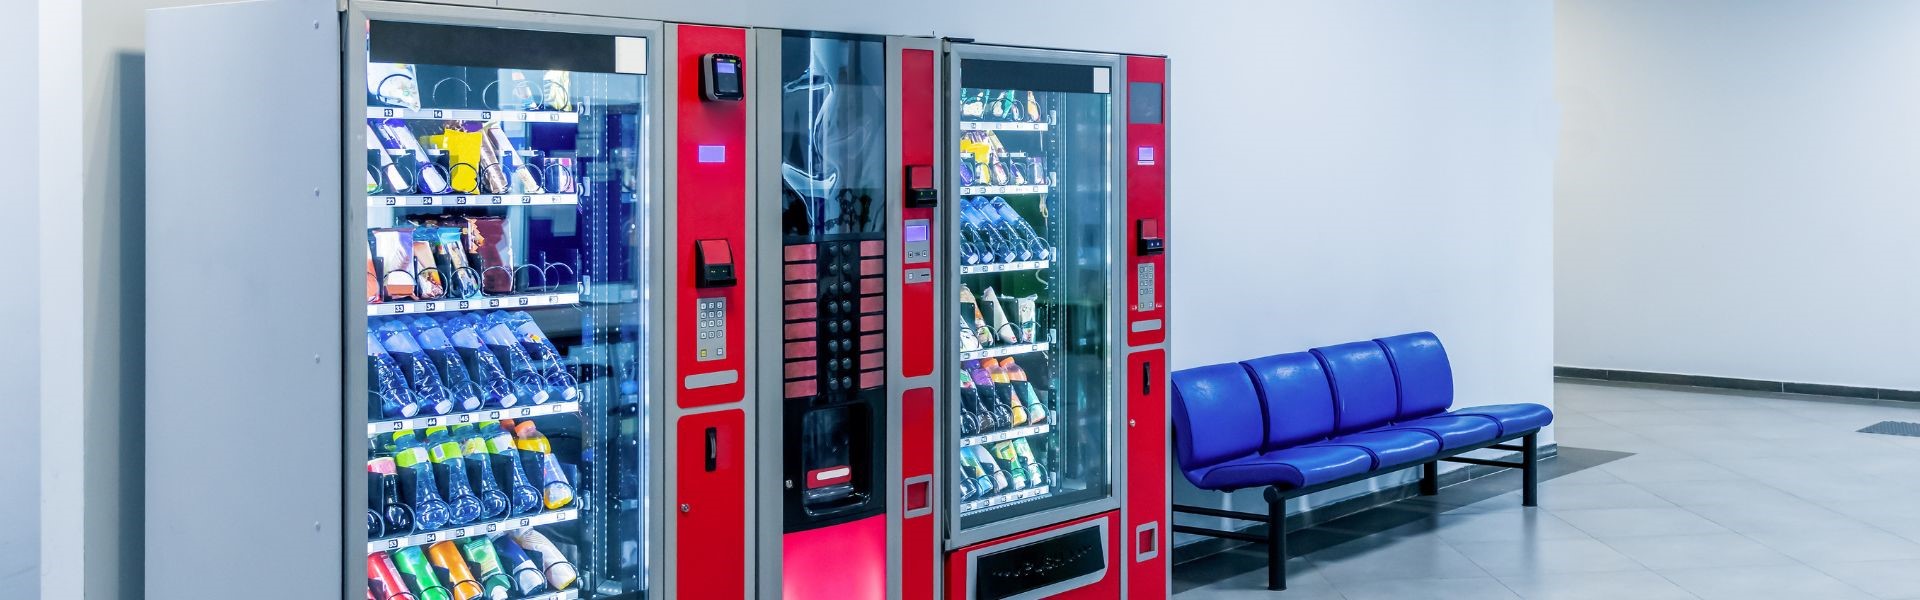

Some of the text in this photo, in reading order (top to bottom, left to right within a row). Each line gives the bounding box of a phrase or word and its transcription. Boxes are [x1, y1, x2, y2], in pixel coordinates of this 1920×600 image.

[384, 109, 393, 117] 13
[434, 110, 442, 118] 14
[423, 197, 432, 205] 24
[426, 303, 435, 311] 34
[460, 301, 469, 309] 35
[519, 297, 528, 305] 37
[394, 422, 402, 430] 43
[428, 418, 437, 426] 44
[460, 414, 469, 423] 45
[389, 540, 398, 548] 53
[427, 533, 436, 542] 54
[487, 523, 496, 532] 56
